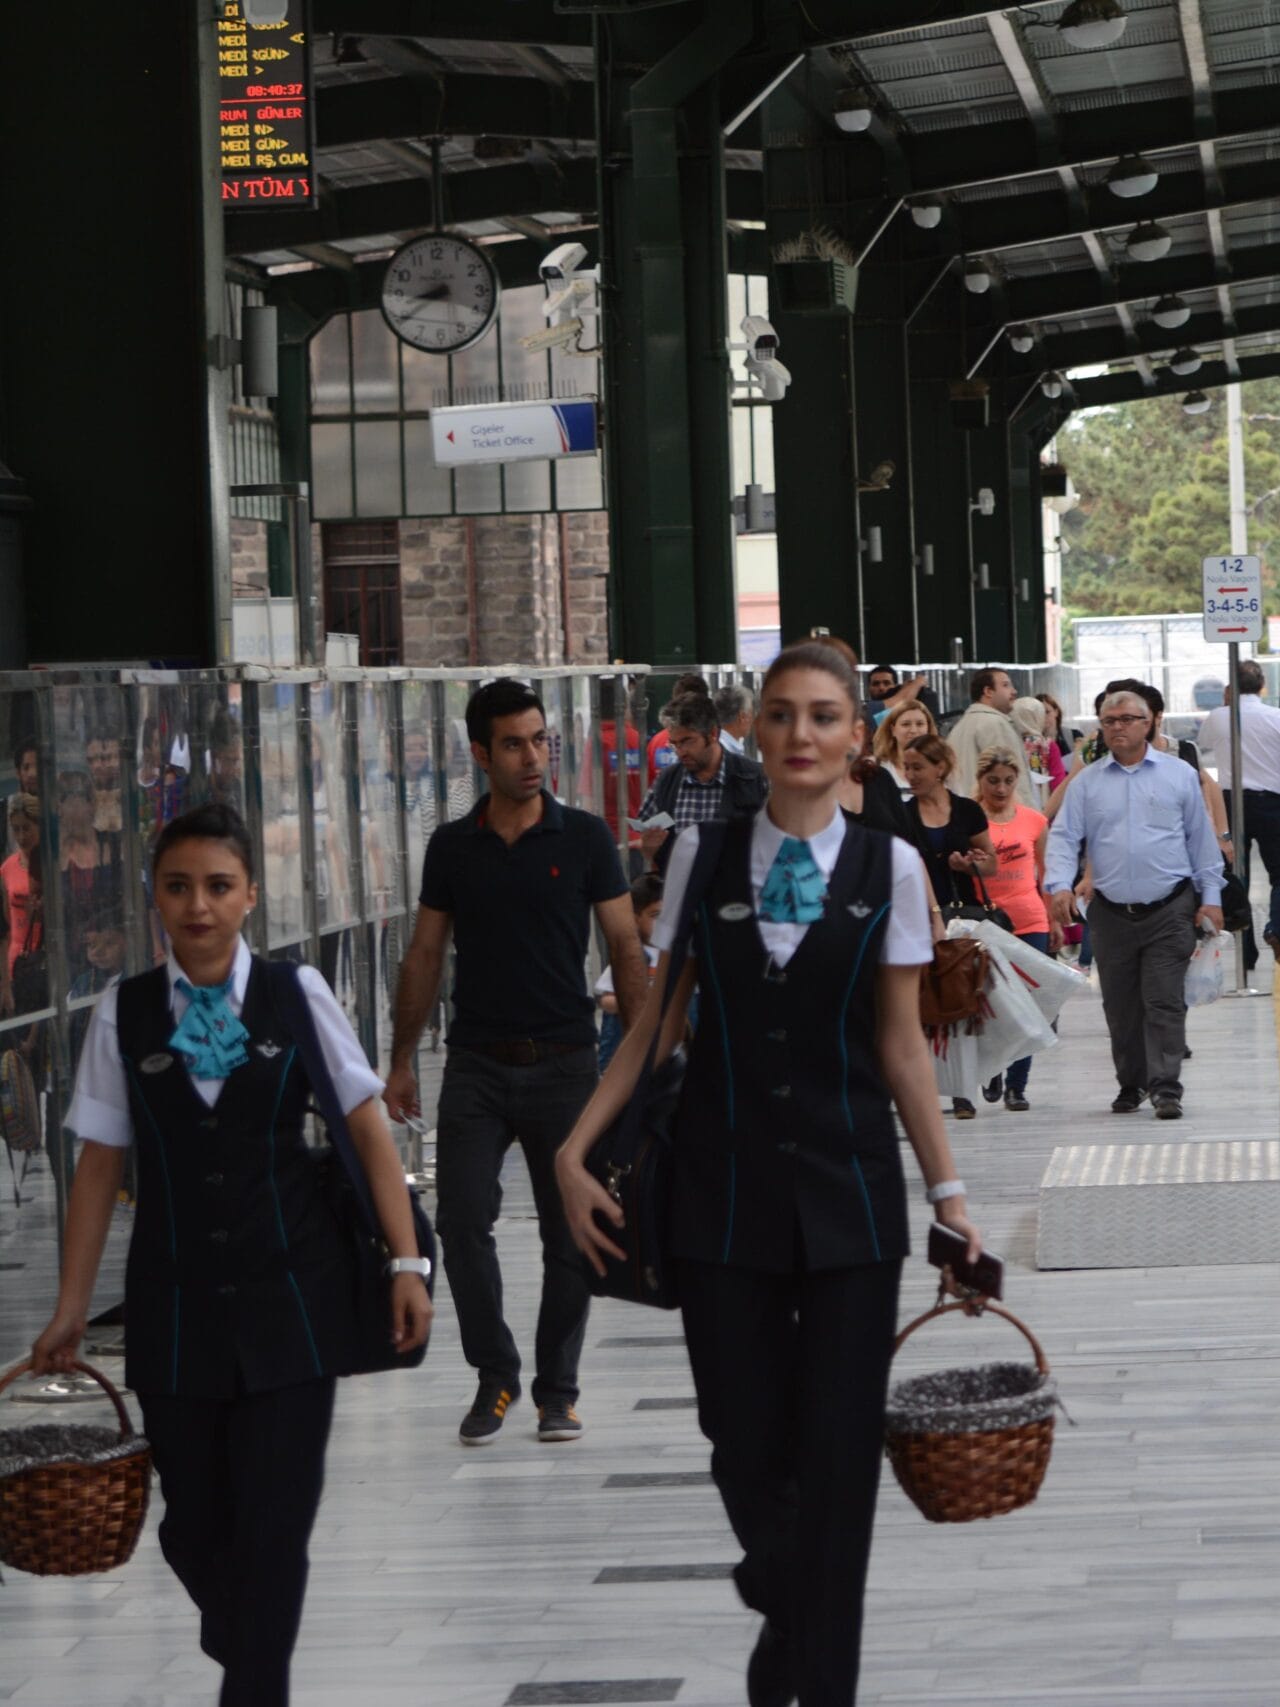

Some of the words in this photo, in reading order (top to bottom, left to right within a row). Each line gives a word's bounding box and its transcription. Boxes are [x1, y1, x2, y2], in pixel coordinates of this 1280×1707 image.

[246, 84, 303, 97] 08:40:37
[220, 109, 248, 121] RUM
[256, 106, 303, 120] GÜNLER
[243, 176, 295, 198] TÜM
[472, 438, 502, 449] Ticket
[503, 435, 535, 447] Office
[1219, 559, 1243, 573] 1-2
[1207, 598, 1259, 614] 3-4-5-6
